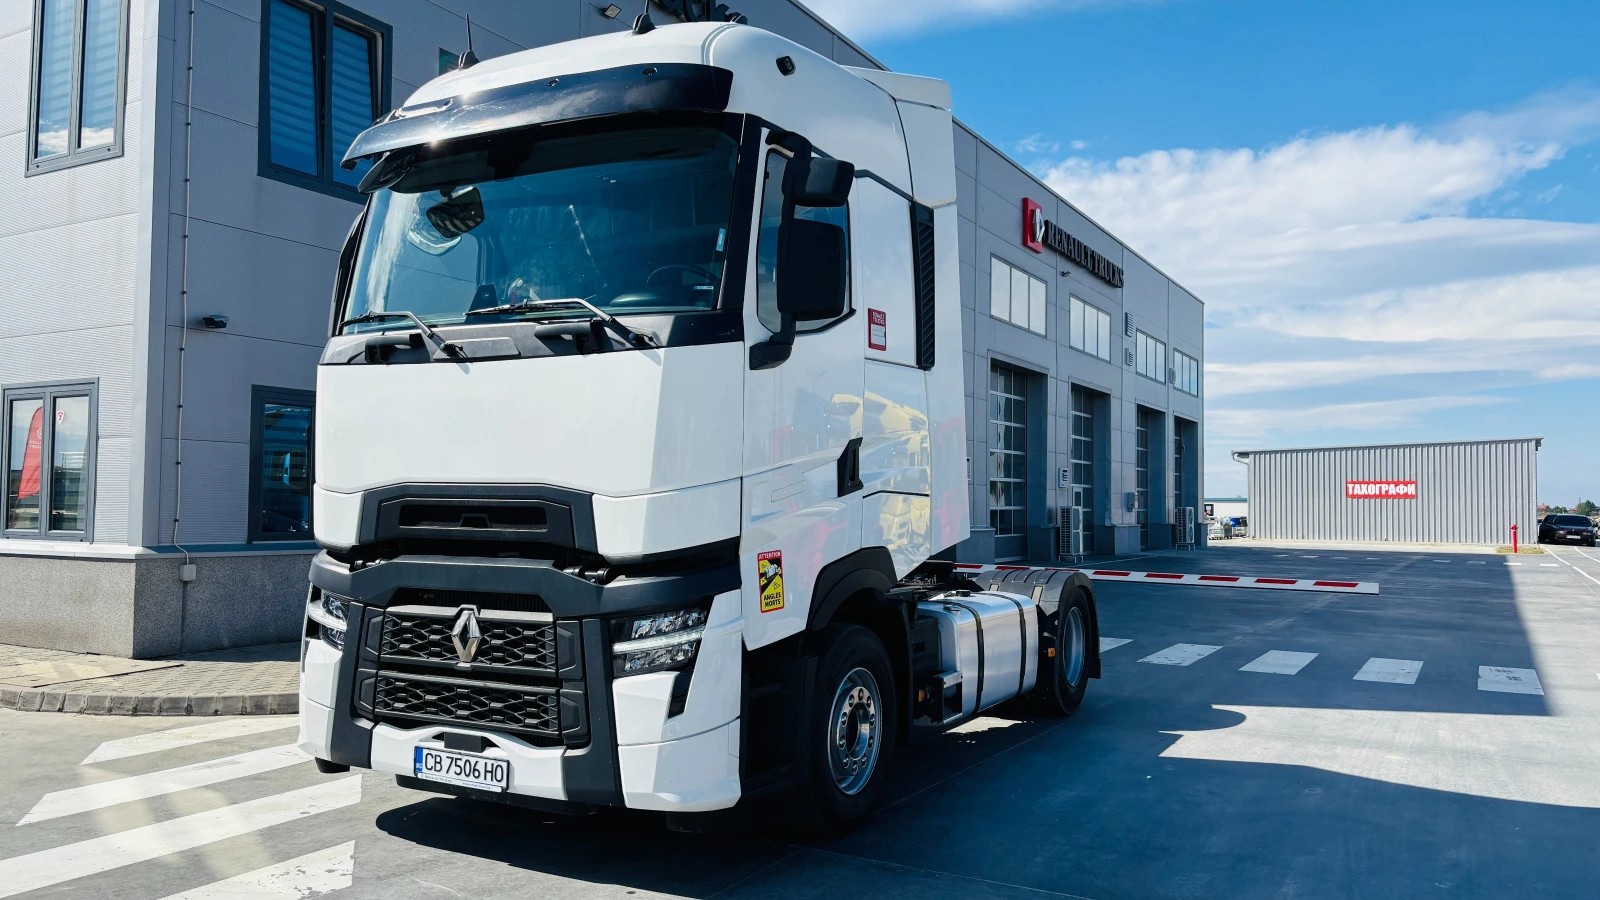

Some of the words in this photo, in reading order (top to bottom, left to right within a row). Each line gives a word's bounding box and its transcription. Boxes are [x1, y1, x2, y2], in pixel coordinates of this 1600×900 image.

[1044, 219, 1093, 271] RENAULT
[1093, 251, 1124, 288] TRUCKS
[1347, 484, 1415, 495] ТАХОГРАФИ
[764, 592, 781, 601] ANGLES
[765, 599, 780, 607] MORTS
[425, 753, 443, 772] CB
[445, 756, 481, 779] 7506
[483, 761, 504, 783] HO
